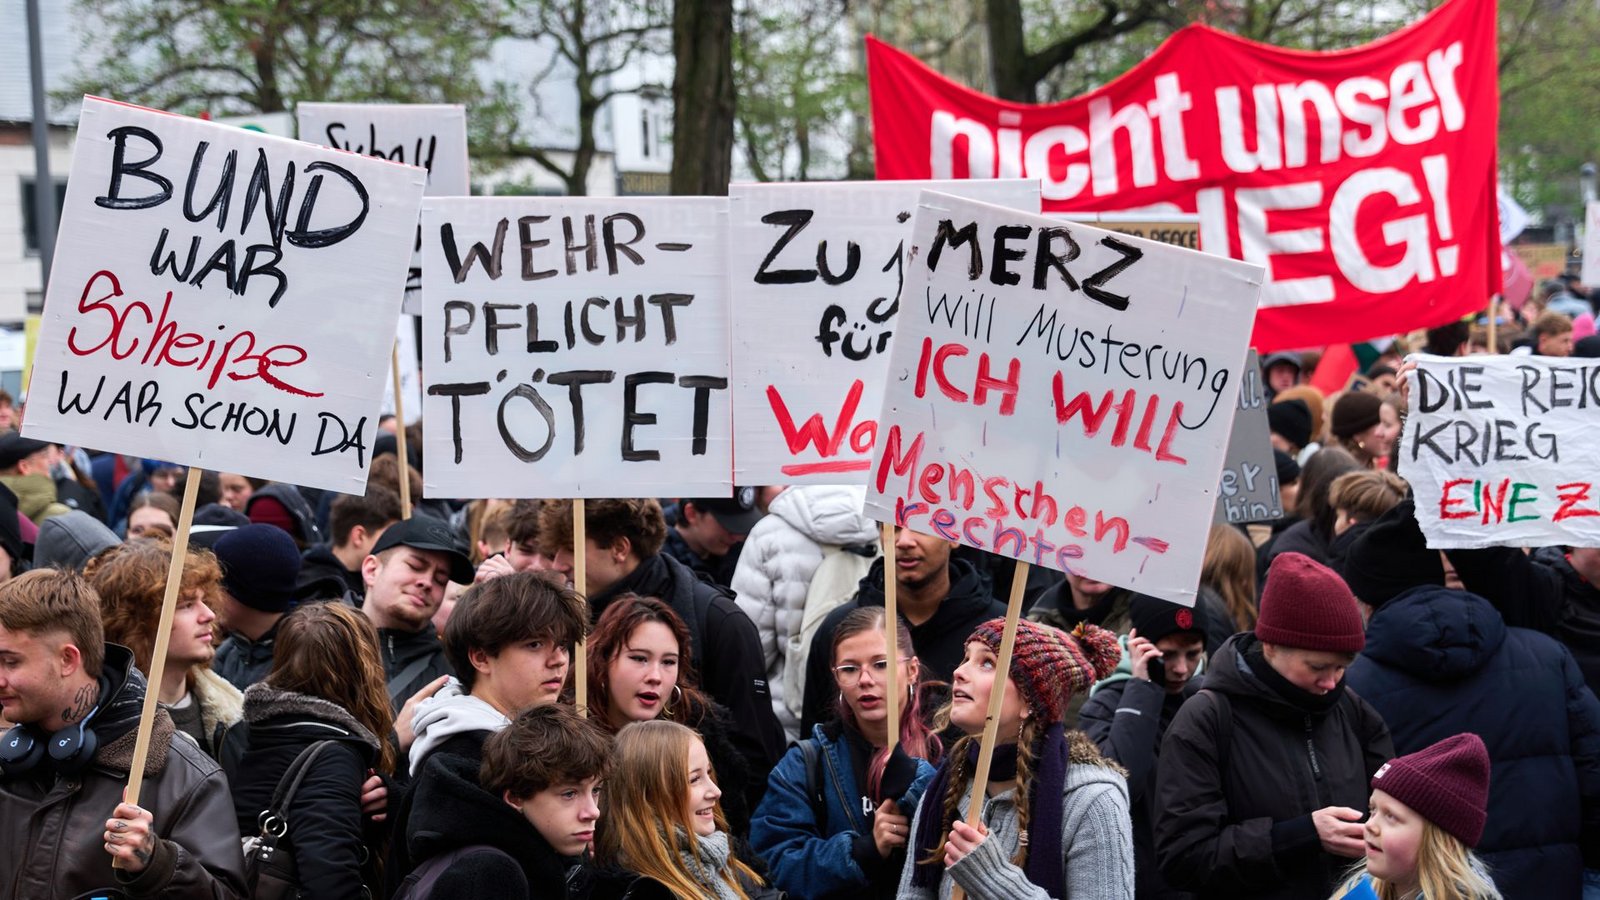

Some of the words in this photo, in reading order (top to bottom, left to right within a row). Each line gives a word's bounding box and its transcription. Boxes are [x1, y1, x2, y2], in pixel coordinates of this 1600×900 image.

[931, 72, 1200, 199] nicht
[1216, 42, 1466, 173] unser
[95, 126, 370, 248] BUND
[150, 228, 288, 308] WAR
[441, 212, 692, 283] WEHR-
[754, 209, 861, 285] Zu
[927, 219, 1144, 311] MERZ
[1130, 155, 1460, 308] IEG!
[444, 294, 695, 363] PFLICHT
[815, 304, 893, 361] für
[1016, 303, 1230, 430] Musterung
[57, 371, 162, 426] WAR
[172, 393, 297, 445] SCHON
[311, 412, 367, 468] DA
[428, 368, 728, 464] TÖTET
[914, 337, 1021, 416] ICH
[1052, 370, 1188, 466] WILL
[1416, 366, 1493, 413] DIE
[1217, 462, 1262, 498] er
[1412, 419, 1559, 467] KRIEG
[876, 424, 1170, 554] Menschen-
[1223, 476, 1281, 523] hin!
[1439, 478, 1541, 525] EINE
[1552, 482, 1600, 522] Z
[895, 496, 1086, 576] rechte
